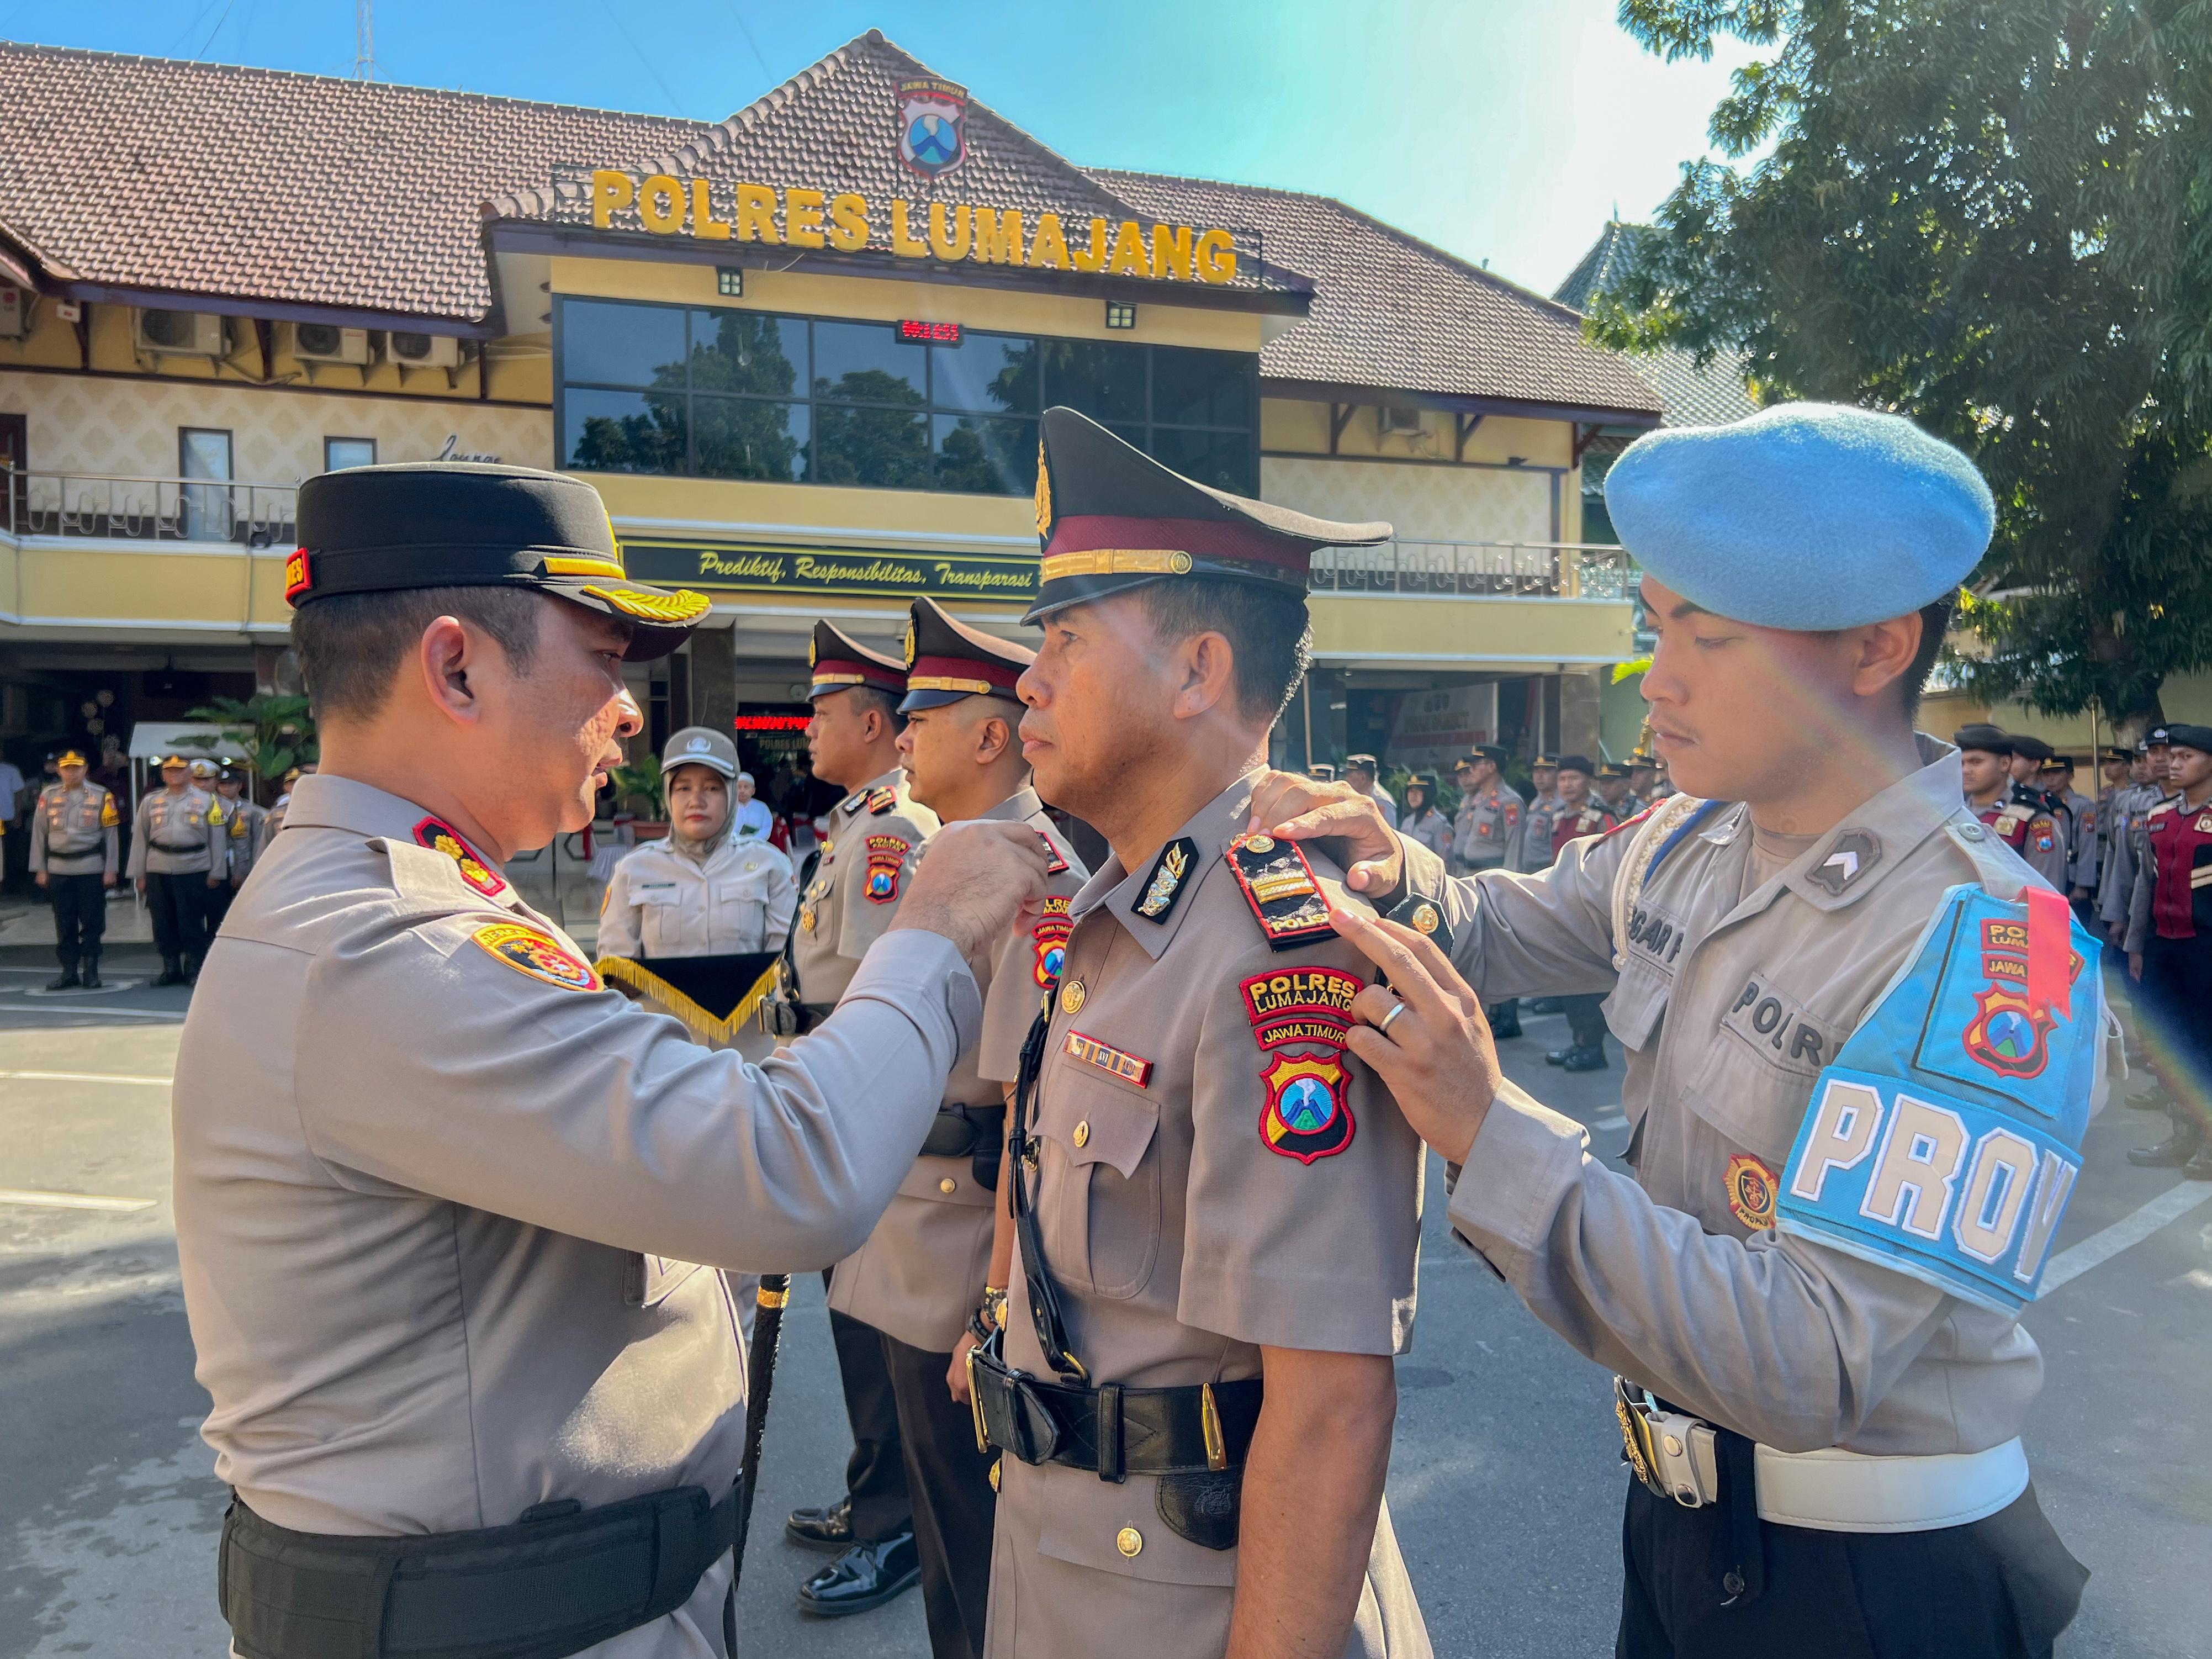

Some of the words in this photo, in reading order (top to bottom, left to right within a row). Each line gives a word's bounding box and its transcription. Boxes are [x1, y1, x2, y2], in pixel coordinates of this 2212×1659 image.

[901, 81, 929, 92] JAWA
[931, 82, 965, 98] TIMUR
[593, 170, 869, 252] POLRES
[892, 199, 1237, 284] LUMAJANG
[700, 551, 787, 584] Prediktif,
[795, 556, 927, 585] Responsibilitas,
[935, 562, 1033, 590] Transparasi
[1038, 924, 1055, 935] JAWA
[1989, 960, 2025, 977] JAWA
[1250, 974, 1355, 1001] POLRES
[1255, 990, 1353, 1013] LUMAJANG
[1265, 1024, 1306, 1043] JAWA
[1305, 1024, 1346, 1043] TIMUR
